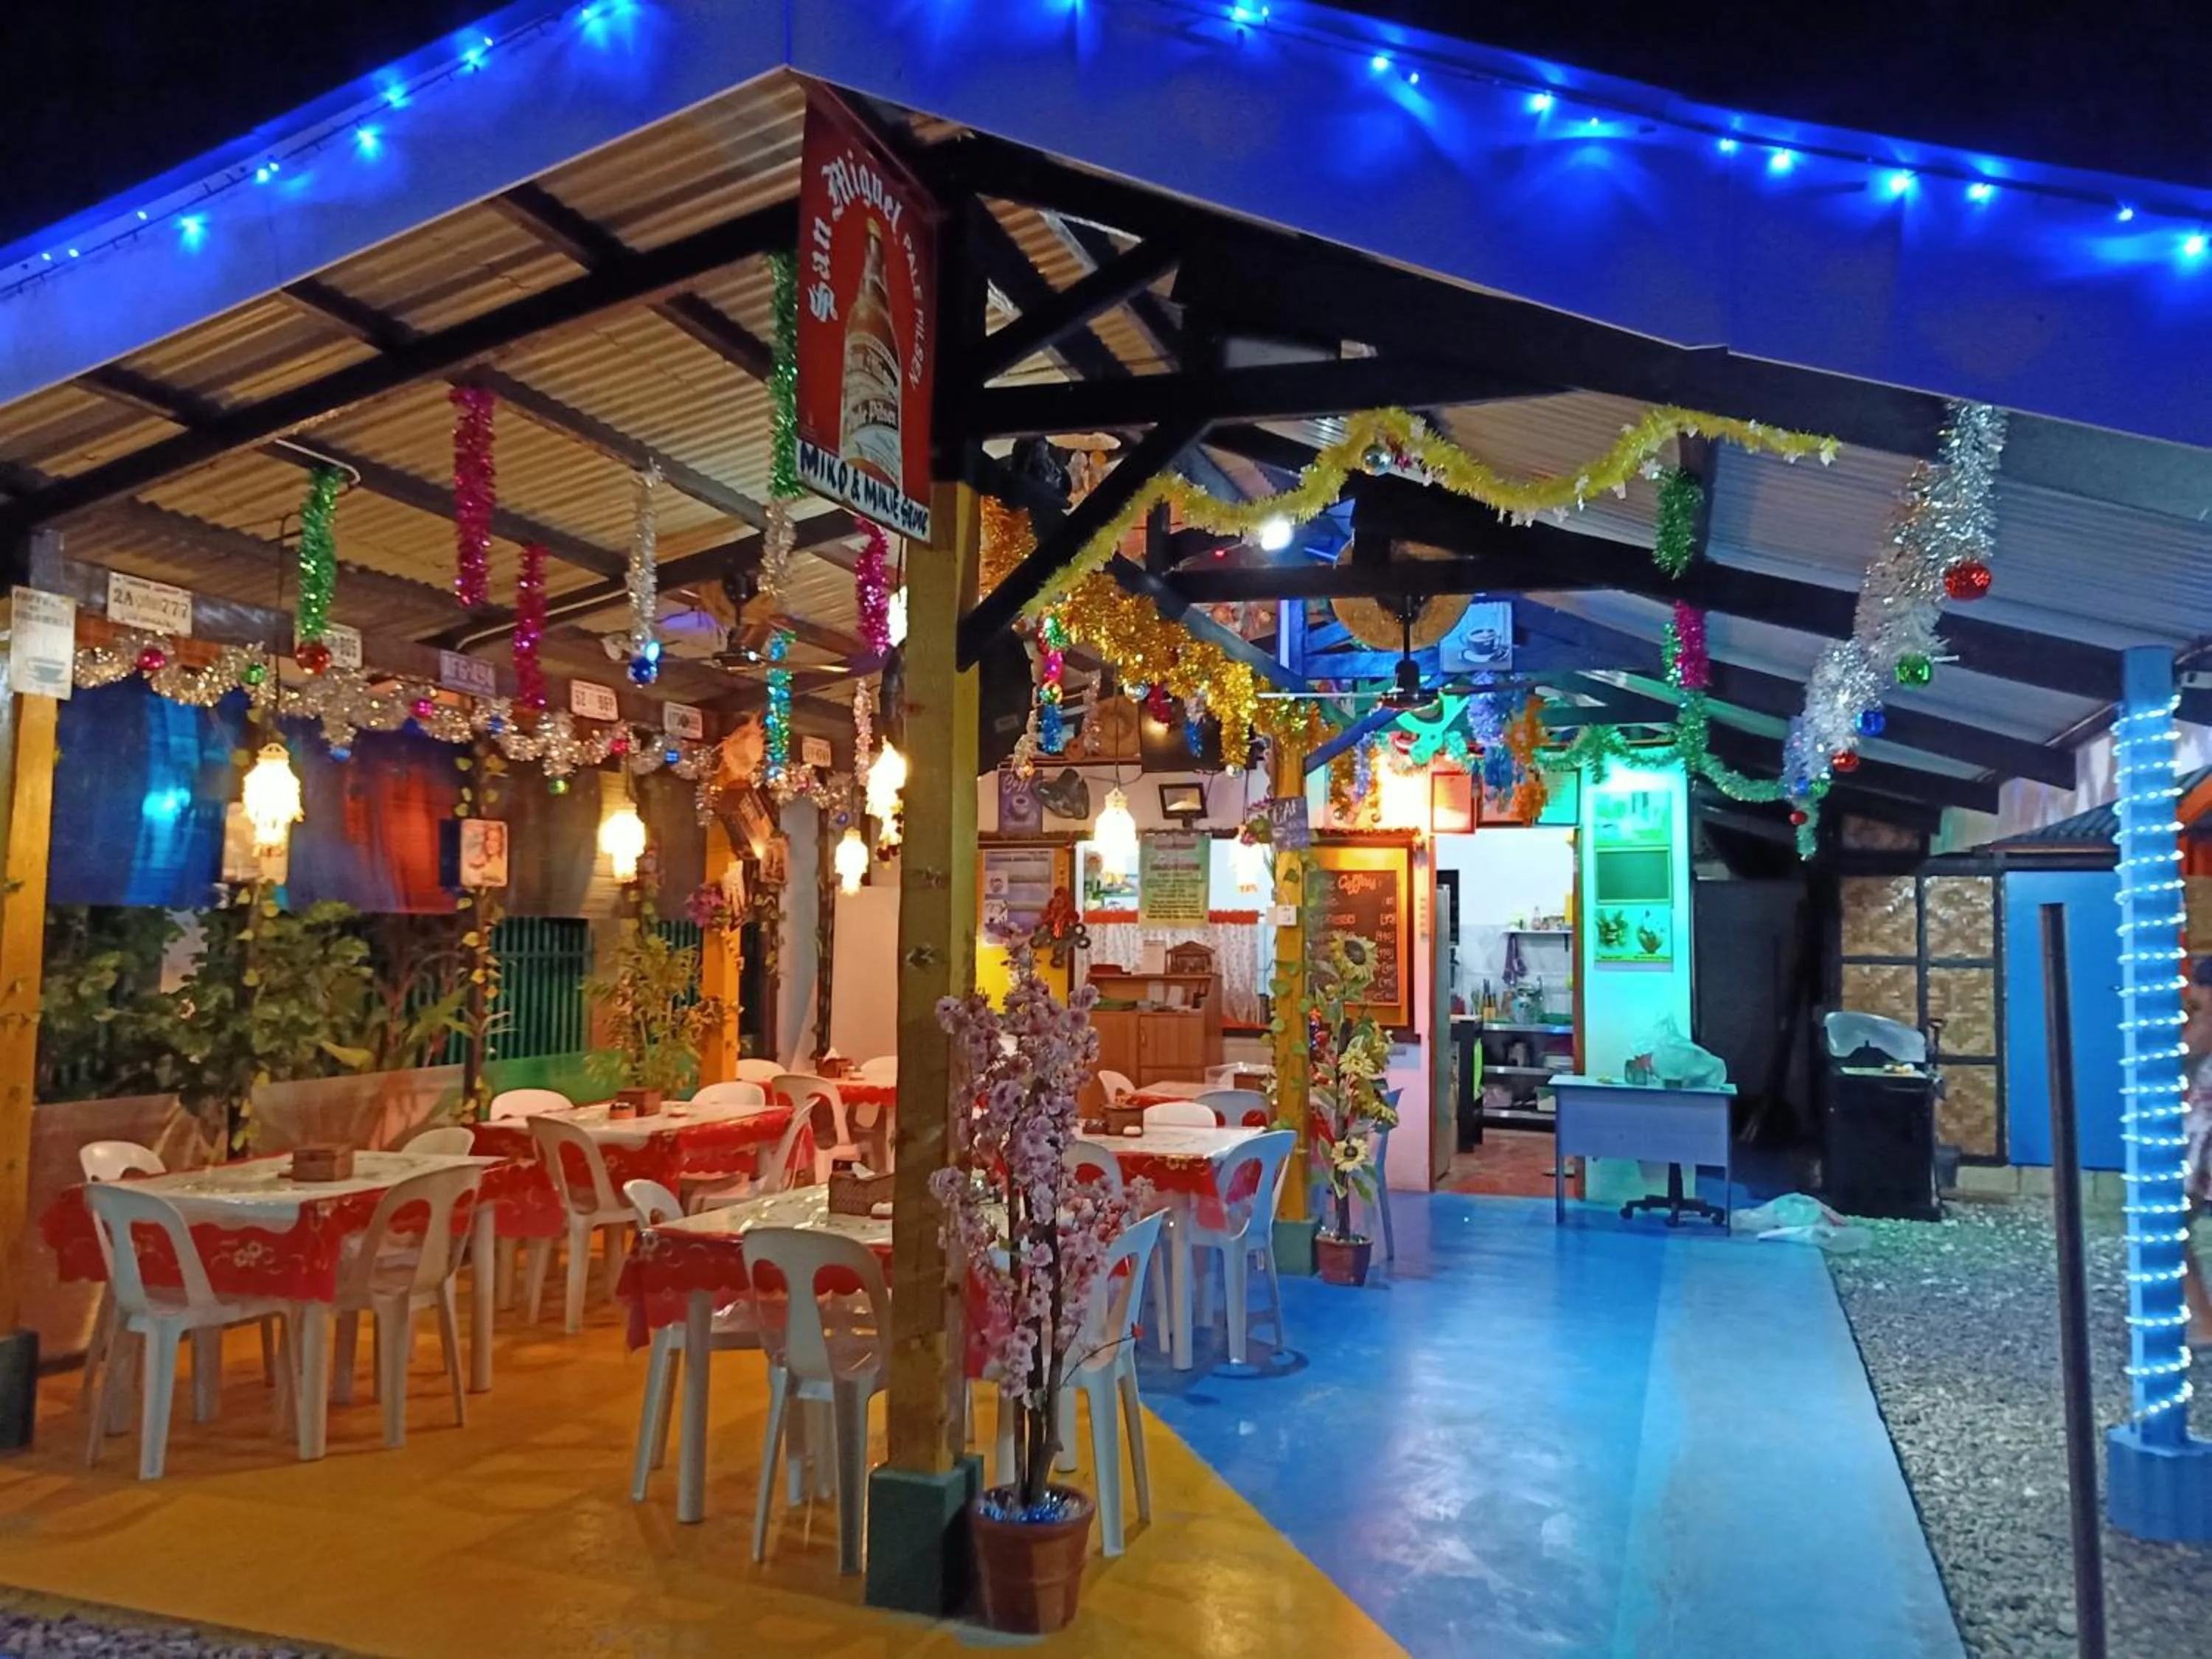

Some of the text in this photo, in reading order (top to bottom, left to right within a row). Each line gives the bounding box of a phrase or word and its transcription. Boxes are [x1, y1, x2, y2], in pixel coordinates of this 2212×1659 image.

[808, 148, 902, 323] San Miguel
[800, 440, 848, 495] MIKO
